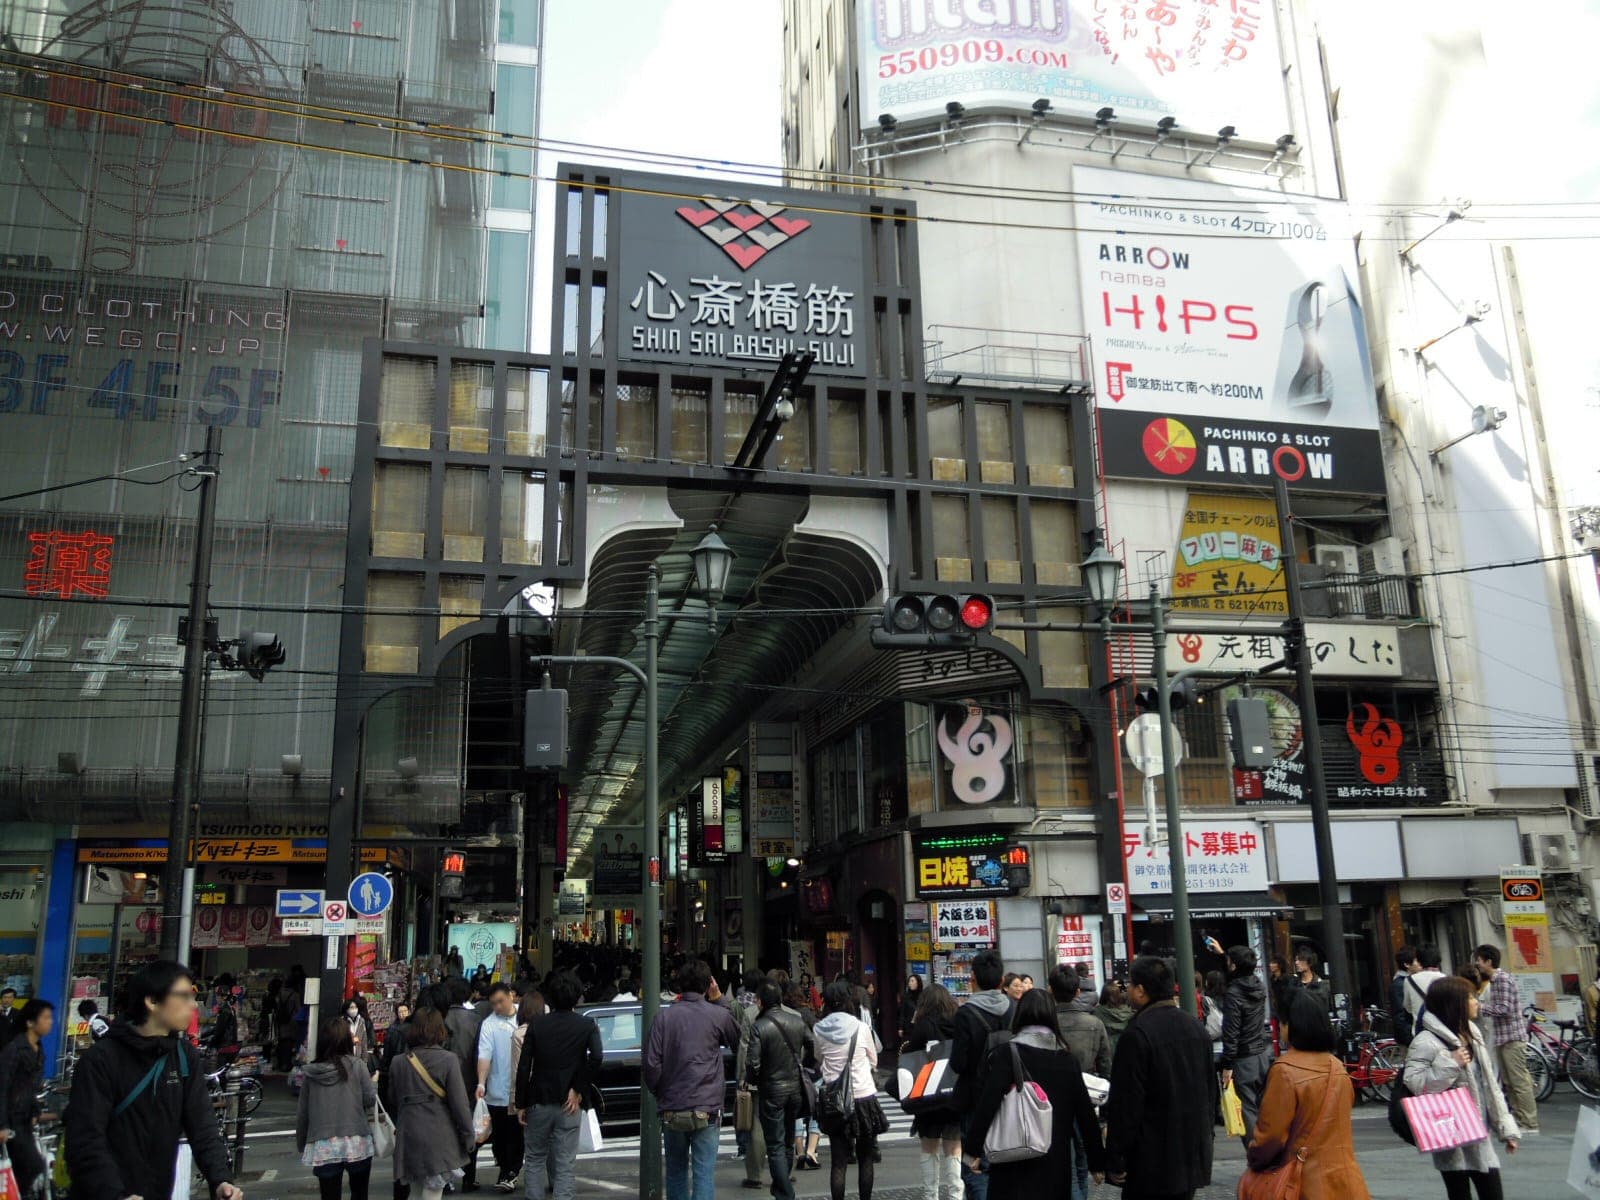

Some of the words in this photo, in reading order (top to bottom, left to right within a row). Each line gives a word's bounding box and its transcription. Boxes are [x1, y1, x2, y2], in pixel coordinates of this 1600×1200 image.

[878, 39, 1068, 78] 550909.COM
[1101, 204, 1173, 221] PACHINKO
[1179, 214, 1187, 223] &
[1193, 215, 1226, 228] SLOT
[1099, 244, 1190, 269] ARROW
[42, 294, 285, 330] CLOTHING
[630, 269, 855, 336] 心斎橋筋
[632, 325, 681, 351] SHIN
[690, 331, 724, 355] SAI
[196, 365, 283, 429] 5F
[1126, 375, 1264, 401] 御堂筋出て南へ約200M
[1203, 427, 1277, 443] PACHINKO
[1282, 433, 1291, 444] &
[1296, 434, 1331, 447] SLOT
[1206, 444, 1333, 482] ARROW
[1185, 510, 1276, 528] 全国チェーンの店
[1186, 537, 1276, 563] フリー麻雀
[24, 532, 113, 600] 薬
[1177, 572, 1197, 588] 3F
[1211, 569, 1256, 594] さん
[1229, 600, 1284, 611] 6212-4773
[1218, 634, 1275, 659] 元祖
[1306, 636, 1394, 665] のした
[711, 783, 719, 820] docomo
[90, 850, 145, 859] Matsumoto
[1123, 832, 1257, 858] テト募集中
[920, 856, 969, 887] 日焼
[1135, 862, 1249, 876] 御堂筋開発株式会社
[938, 907, 988, 921] 大阪名物
[938, 925, 990, 937] 鉄板もつ鍋
